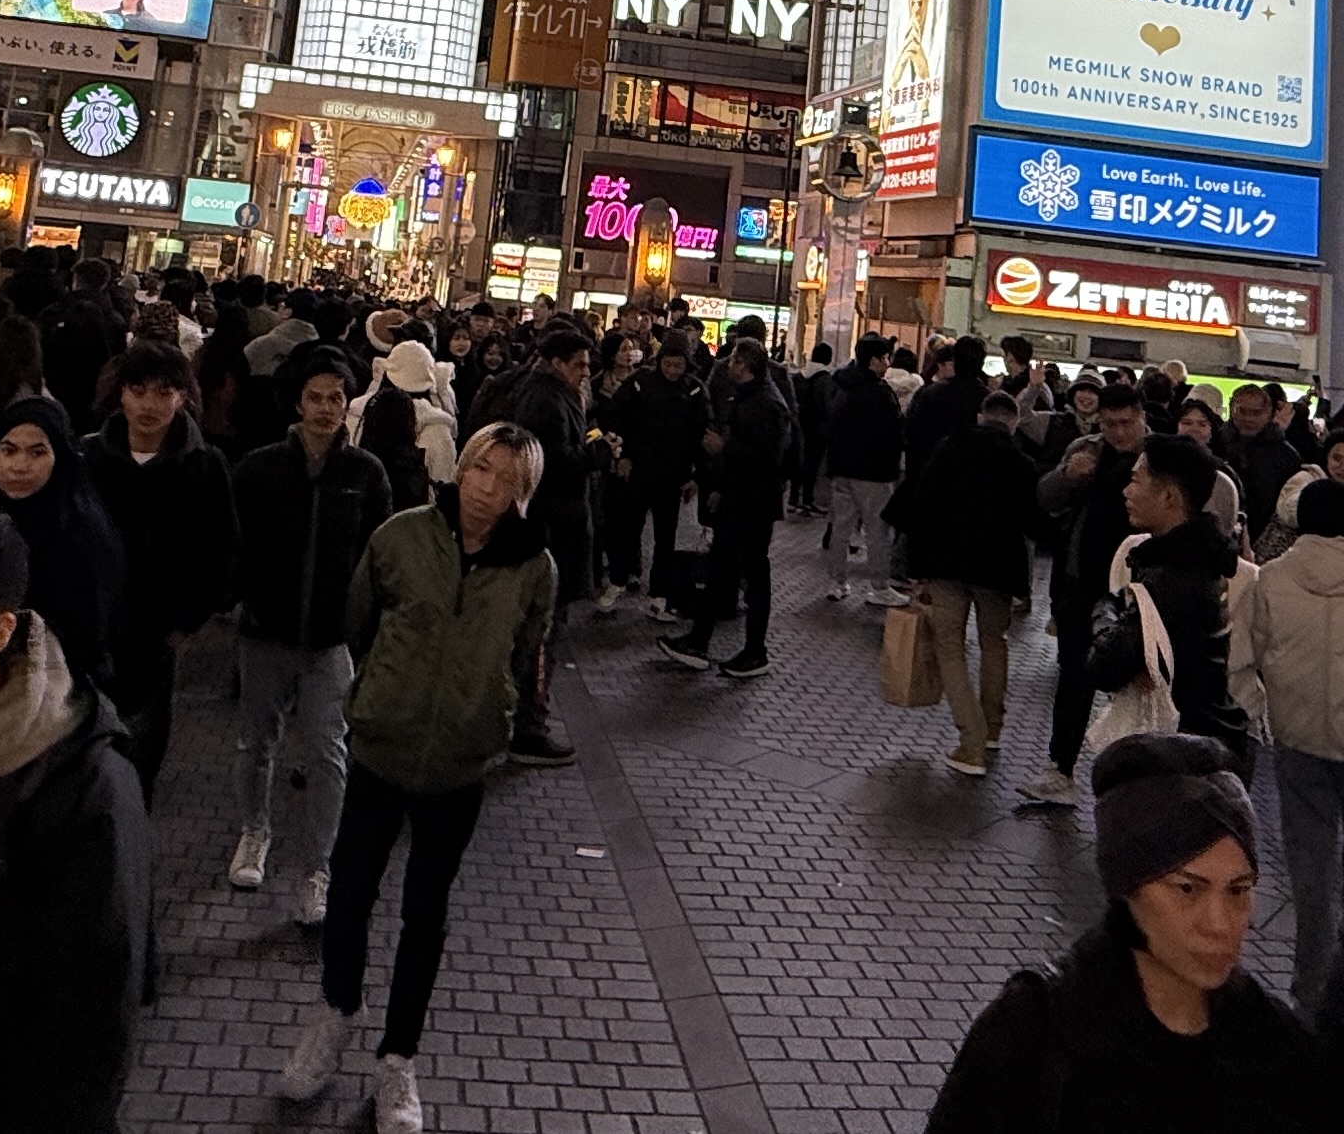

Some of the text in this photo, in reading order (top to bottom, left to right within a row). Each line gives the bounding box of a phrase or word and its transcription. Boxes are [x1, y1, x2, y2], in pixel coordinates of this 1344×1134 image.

[372, 22, 408, 39] なんば
[356, 34, 419, 62] 戎橋筋
[112, 63, 139, 74] POINT
[1048, 56, 1264, 99] MEGMILK SNOW BRAND
[1011, 77, 1059, 98] 100th
[40, 167, 171, 206] TSUTAYA
[587, 175, 631, 201] 最大
[1103, 165, 1266, 198] Love Earth. Love Life.
[1089, 189, 1277, 238] 雪印メグミルク
[1047, 270, 1232, 326] ZETTERIA
